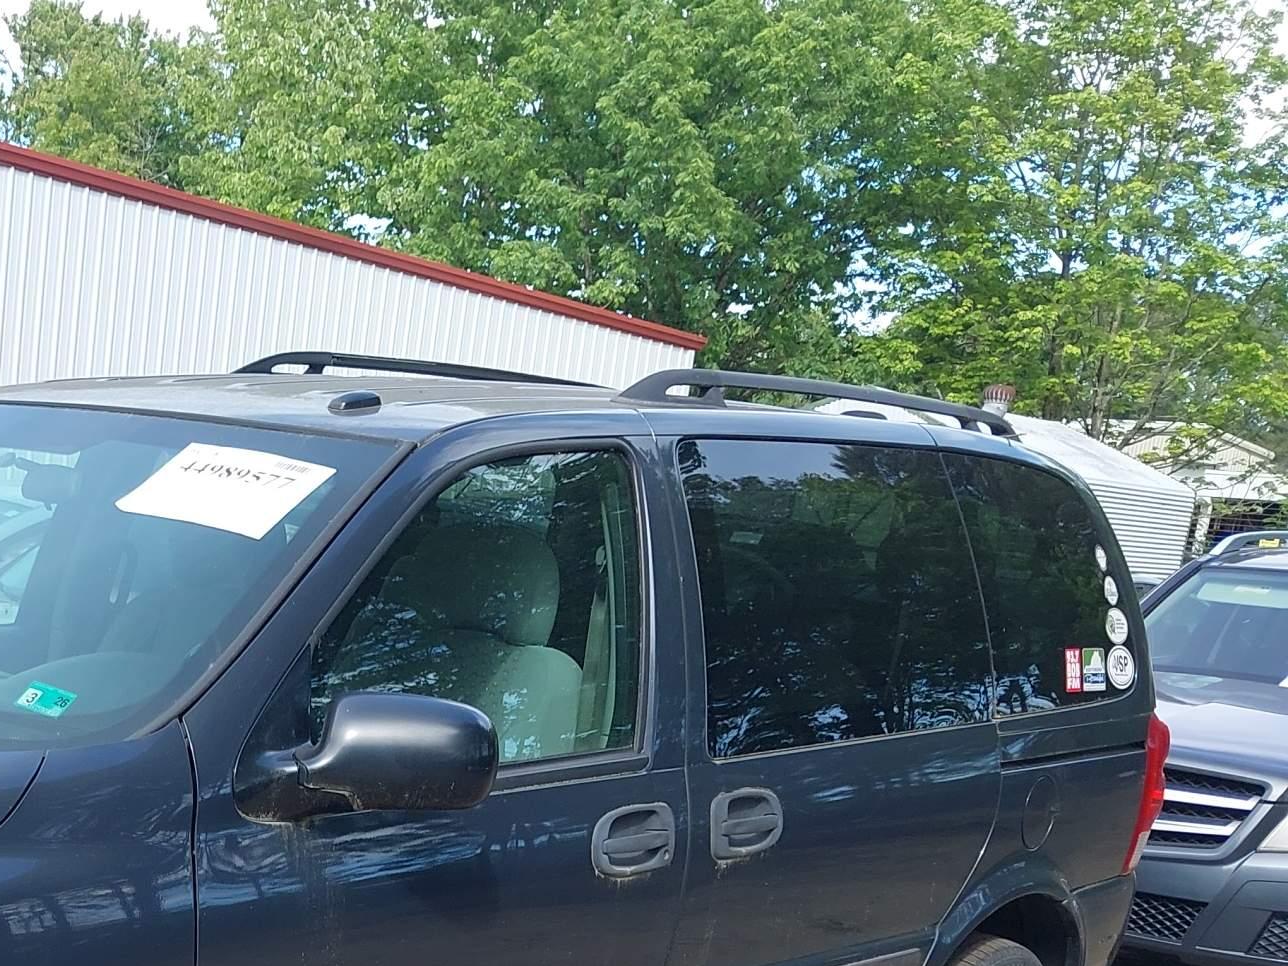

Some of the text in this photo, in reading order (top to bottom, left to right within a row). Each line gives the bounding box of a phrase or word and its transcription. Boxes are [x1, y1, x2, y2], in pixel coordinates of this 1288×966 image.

[180, 461, 297, 488] 44989577
[1067, 677, 1081, 689] FM
[26, 692, 39, 704] 3
[54, 696, 70, 708] 26
